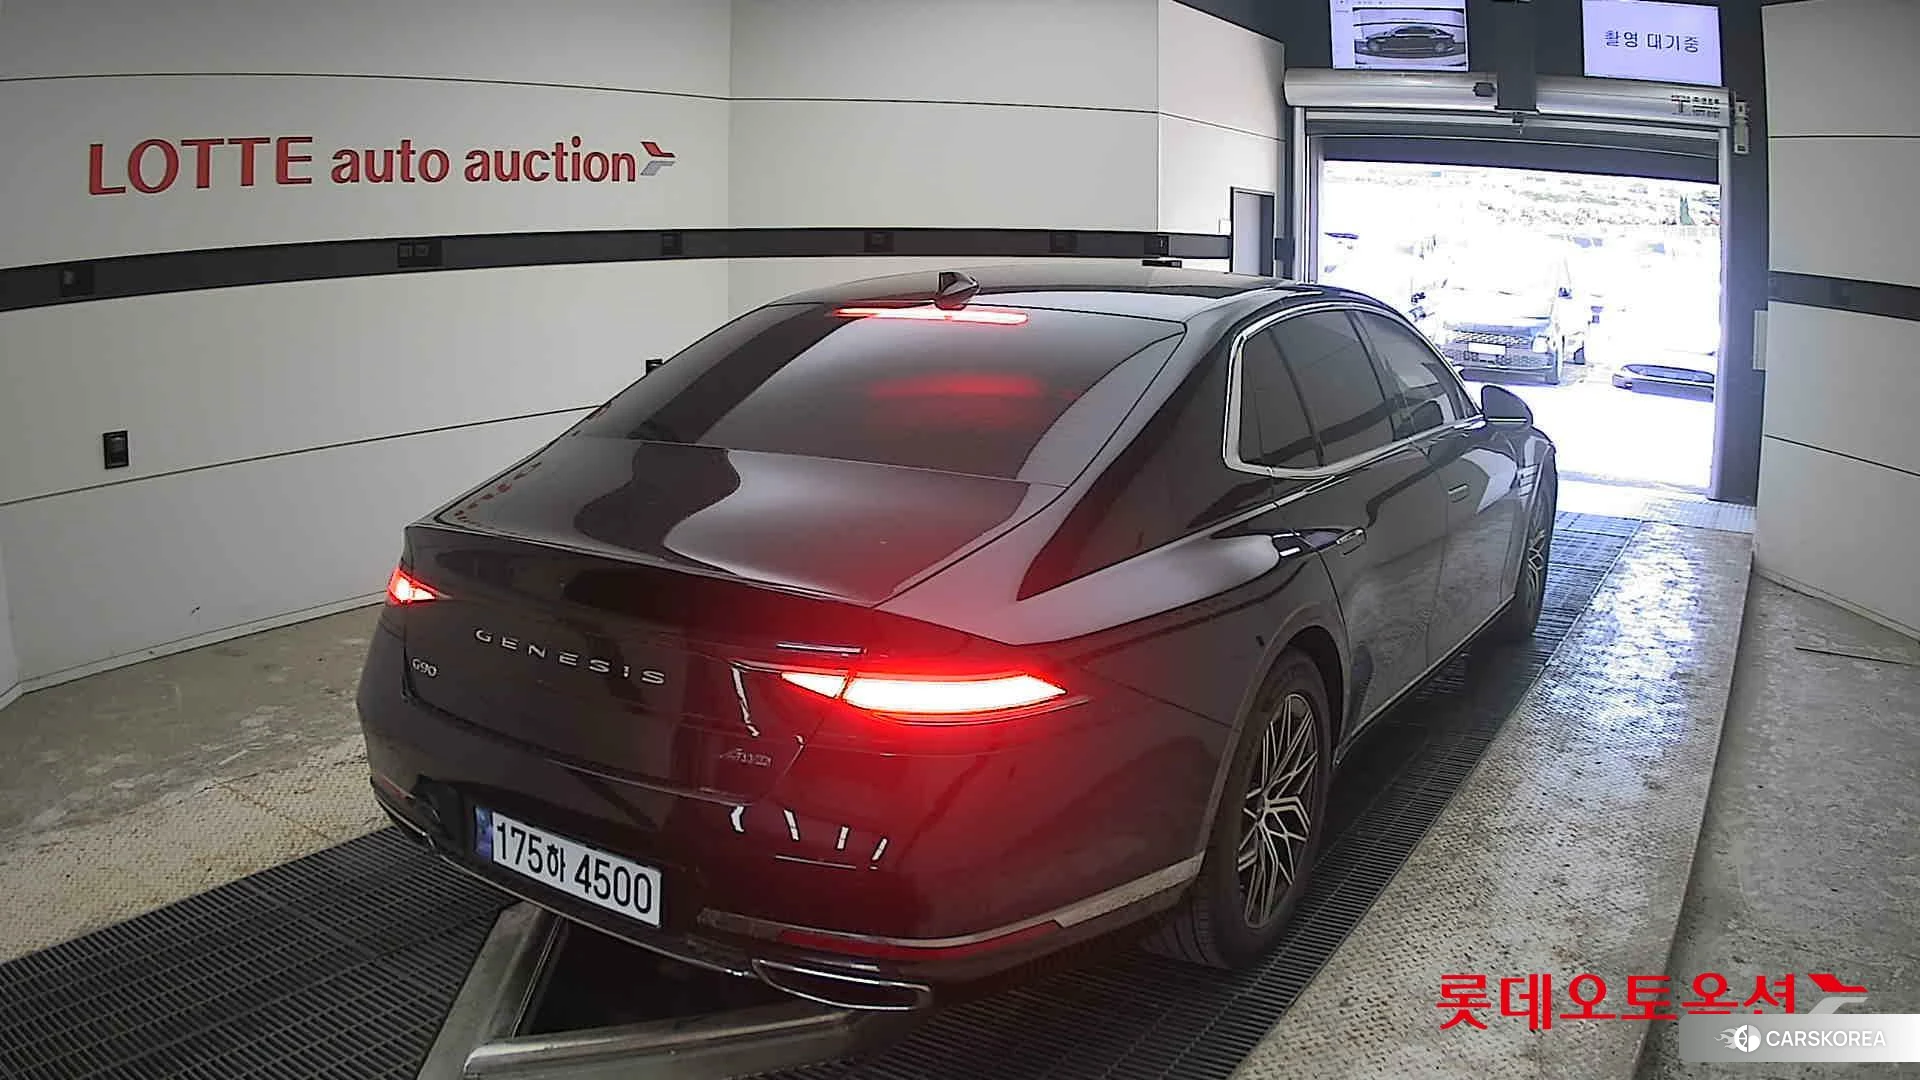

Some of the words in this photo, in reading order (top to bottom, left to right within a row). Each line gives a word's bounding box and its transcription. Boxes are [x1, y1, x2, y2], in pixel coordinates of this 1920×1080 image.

[1604, 30, 1639, 48] 촬영
[1647, 33, 1699, 53] 대기중
[88, 136, 313, 195] LOTTE
[331, 139, 450, 184] auto
[464, 135, 637, 183] auction
[411, 658, 437, 677] G90
[474, 629, 665, 685] GENESIS
[497, 822, 566, 883] 175하
[574, 854, 652, 914] 4500
